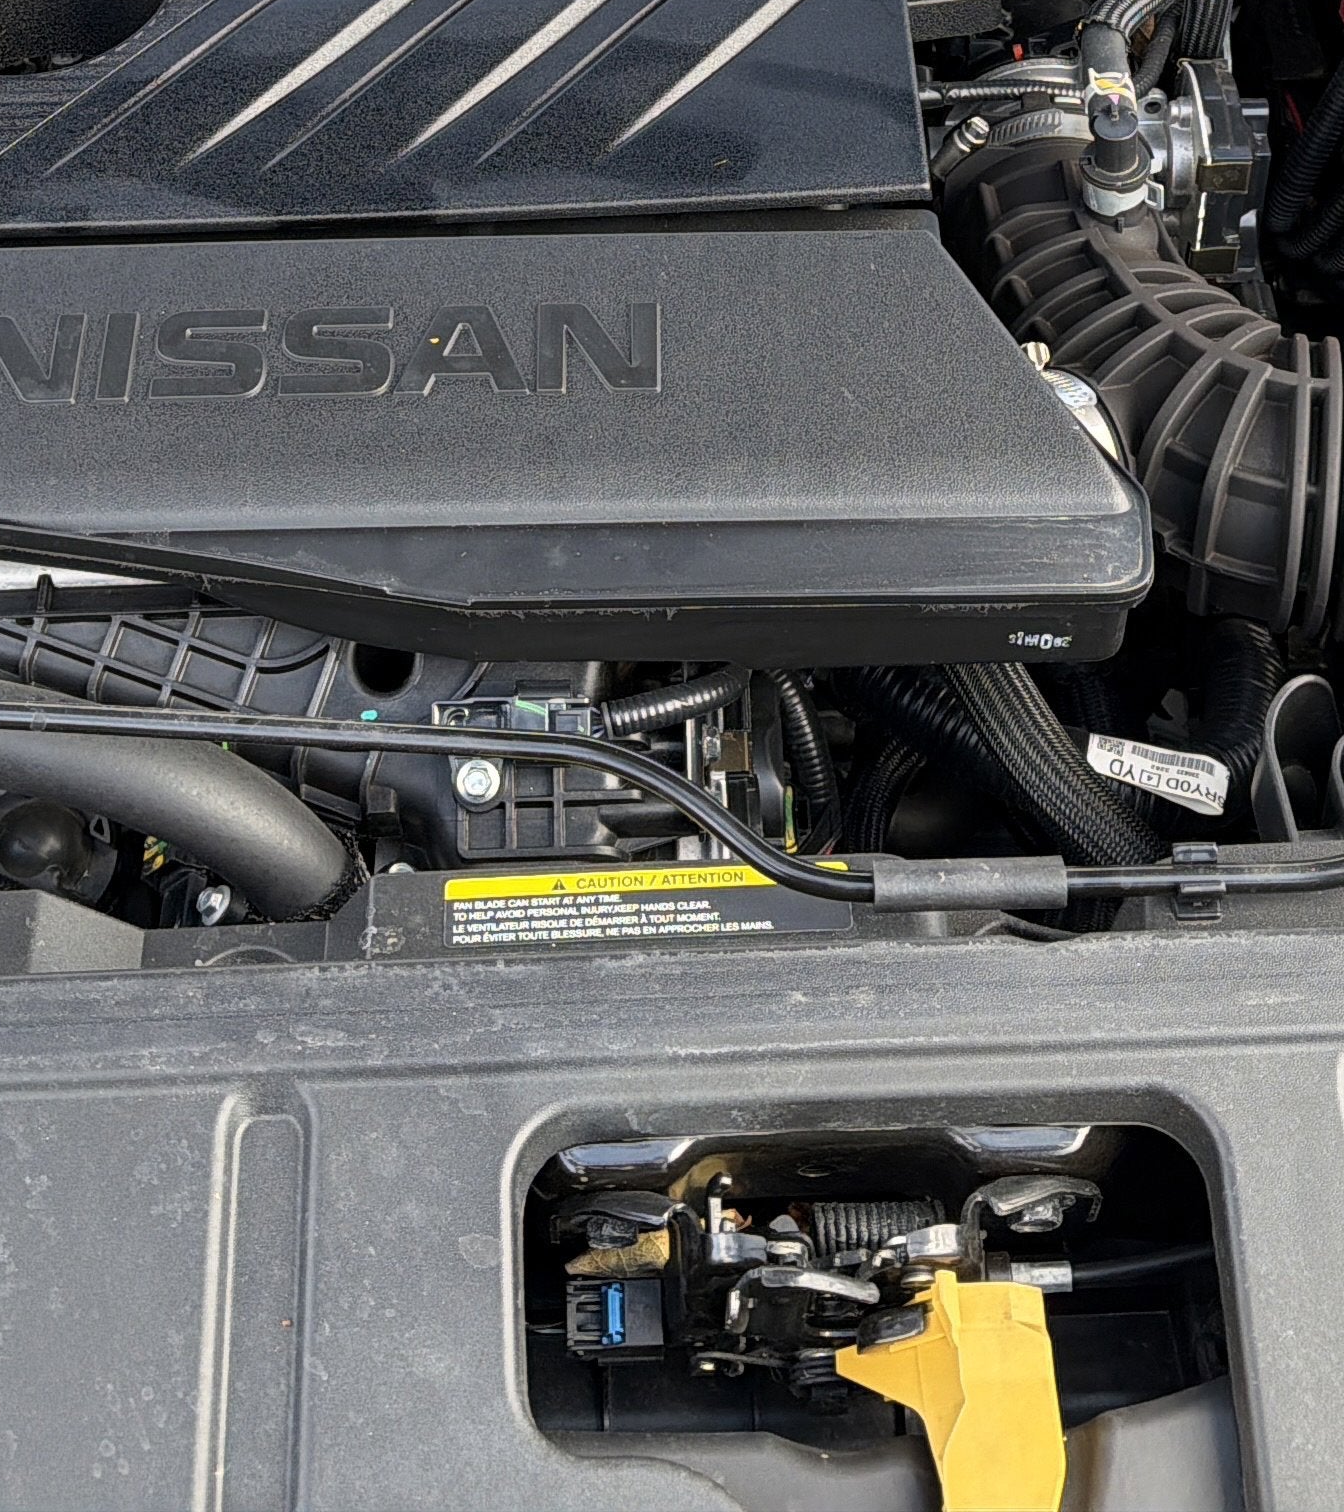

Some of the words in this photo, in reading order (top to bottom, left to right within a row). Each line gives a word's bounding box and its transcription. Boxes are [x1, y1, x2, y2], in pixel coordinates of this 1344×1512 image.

[1109, 758, 1137, 780] YD
[576, 875, 644, 889] CAUTION
[649, 875, 656, 886] /
[661, 871, 744, 886] ATTENTION
[453, 912, 467, 922] TO
[469, 910, 495, 921] HELP
[495, 909, 526, 919] AVOID
[527, 906, 580, 918] PERSONAL
[641, 901, 676, 912] HANDS
[677, 901, 711, 911] CLEAR.
[454, 901, 473, 911] FAN
[474, 900, 506, 910] BLADE
[508, 898, 529, 908] CAN
[531, 896, 561, 907] START
[562, 896, 574, 905] AT
[576, 895, 598, 904] ANY
[598, 894, 623, 903] TIME.
[453, 924, 465, 934] LE
[466, 921, 530, 933] VENTILATEUR
[531, 919, 567, 930] RISQUE
[569, 918, 584, 928] DE
[585, 915, 639, 926] DÉMARRER
[640, 913, 648, 924] À
[649, 914, 675, 924] TOUT
[676, 912, 721, 923] MOMENT.
[453, 935, 482, 945] POUR
[482, 931, 517, 943] ÉVITER
[518, 931, 549, 941] TOUTE
[606, 927, 620, 937] NE
[622, 927, 641, 936] PAS
[643, 925, 656, 935] EN
[658, 923, 720, 934] APPROCHER
[721, 921, 740, 931] LES
[741, 920, 774, 931] MAINS.
